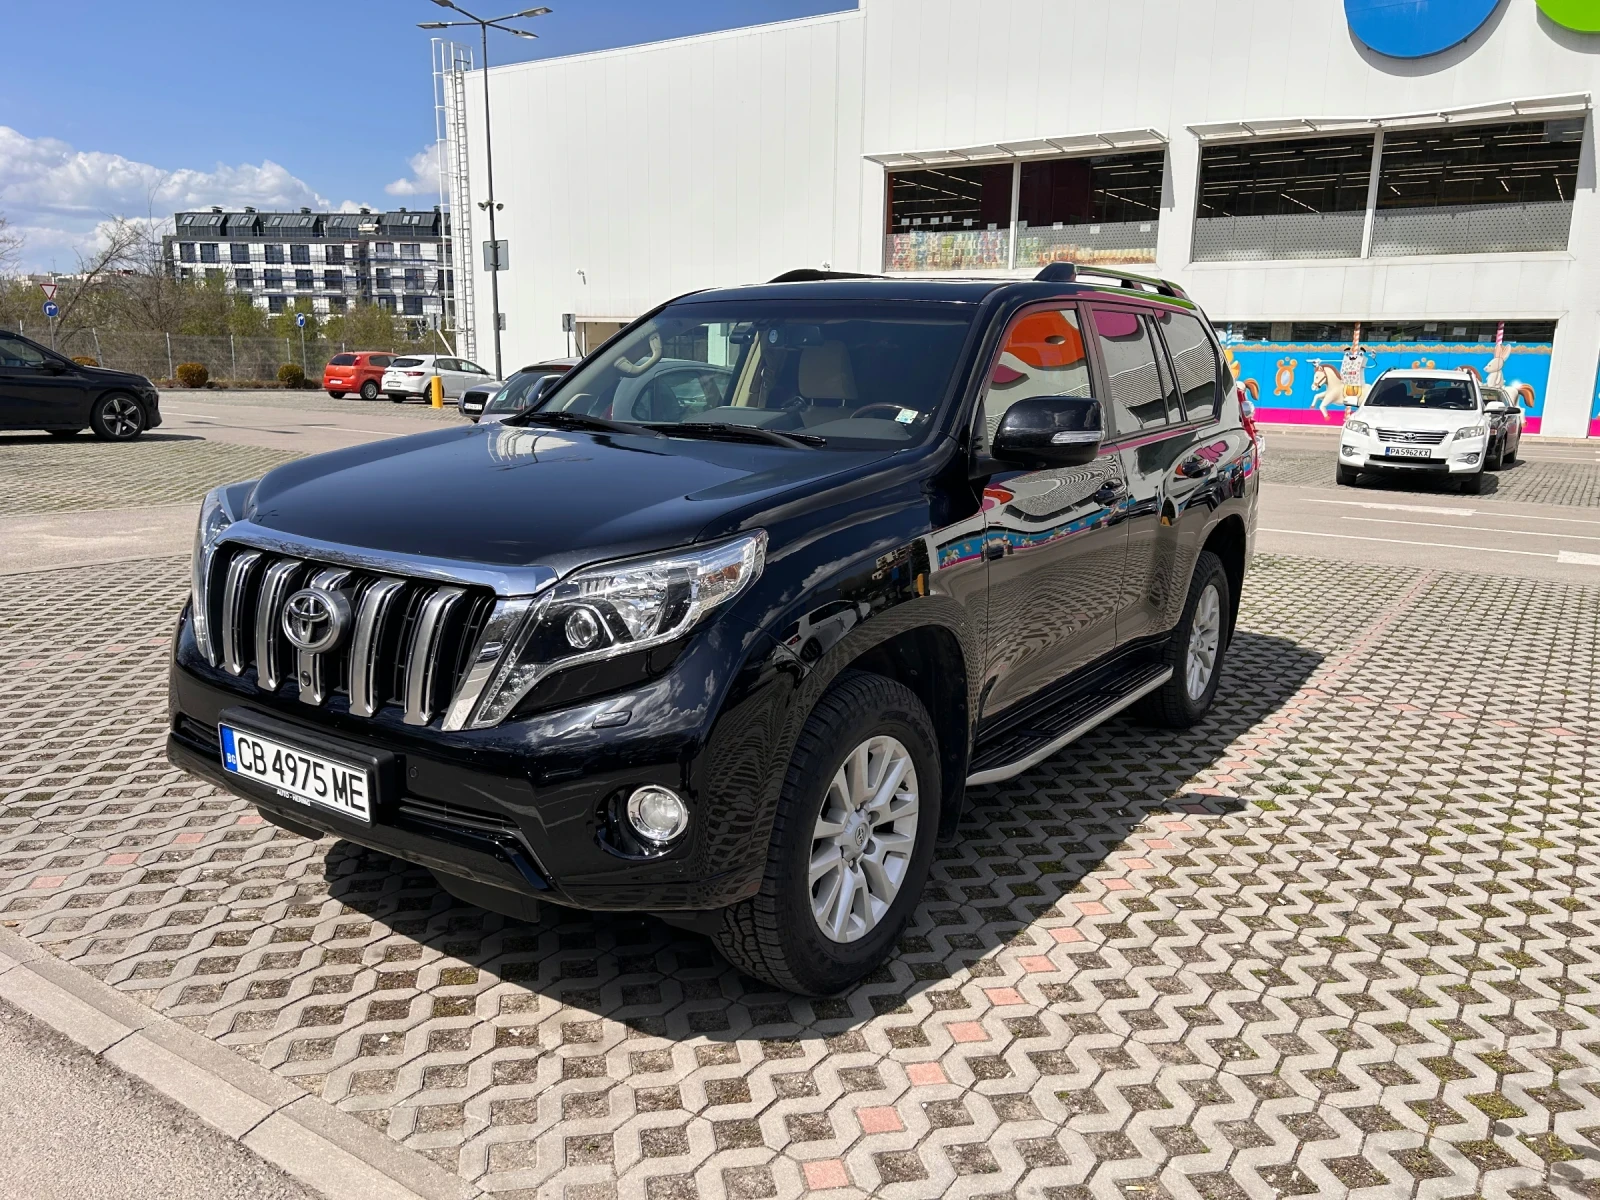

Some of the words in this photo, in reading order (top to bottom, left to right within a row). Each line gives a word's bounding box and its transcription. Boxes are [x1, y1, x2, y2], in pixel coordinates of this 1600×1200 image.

[227, 753, 236, 764] BG
[238, 737, 267, 775] CB
[272, 749, 328, 798] 4975
[332, 767, 366, 812] ME
